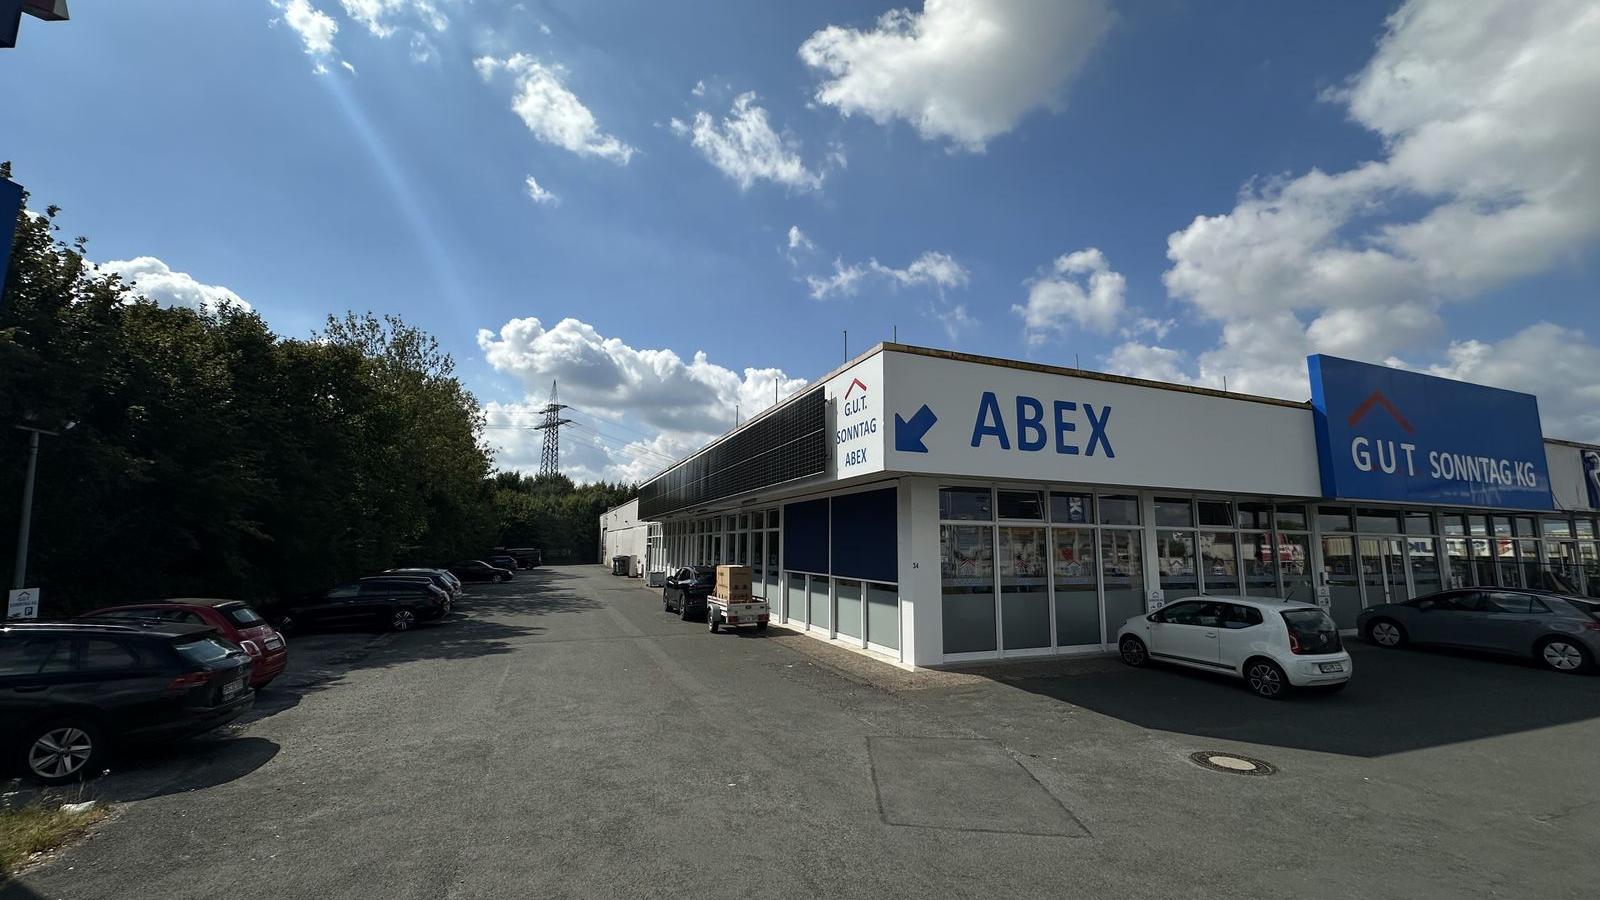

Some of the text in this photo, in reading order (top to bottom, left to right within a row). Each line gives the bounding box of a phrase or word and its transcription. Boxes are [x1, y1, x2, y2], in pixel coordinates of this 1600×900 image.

[844, 395, 867, 418] G.U.T.
[836, 417, 877, 444] SONNTAG
[970, 391, 1115, 458] ABEX
[845, 447, 867, 467] ABEX
[1429, 451, 1512, 486] SONNTAG
[1514, 461, 1536, 487] KG
